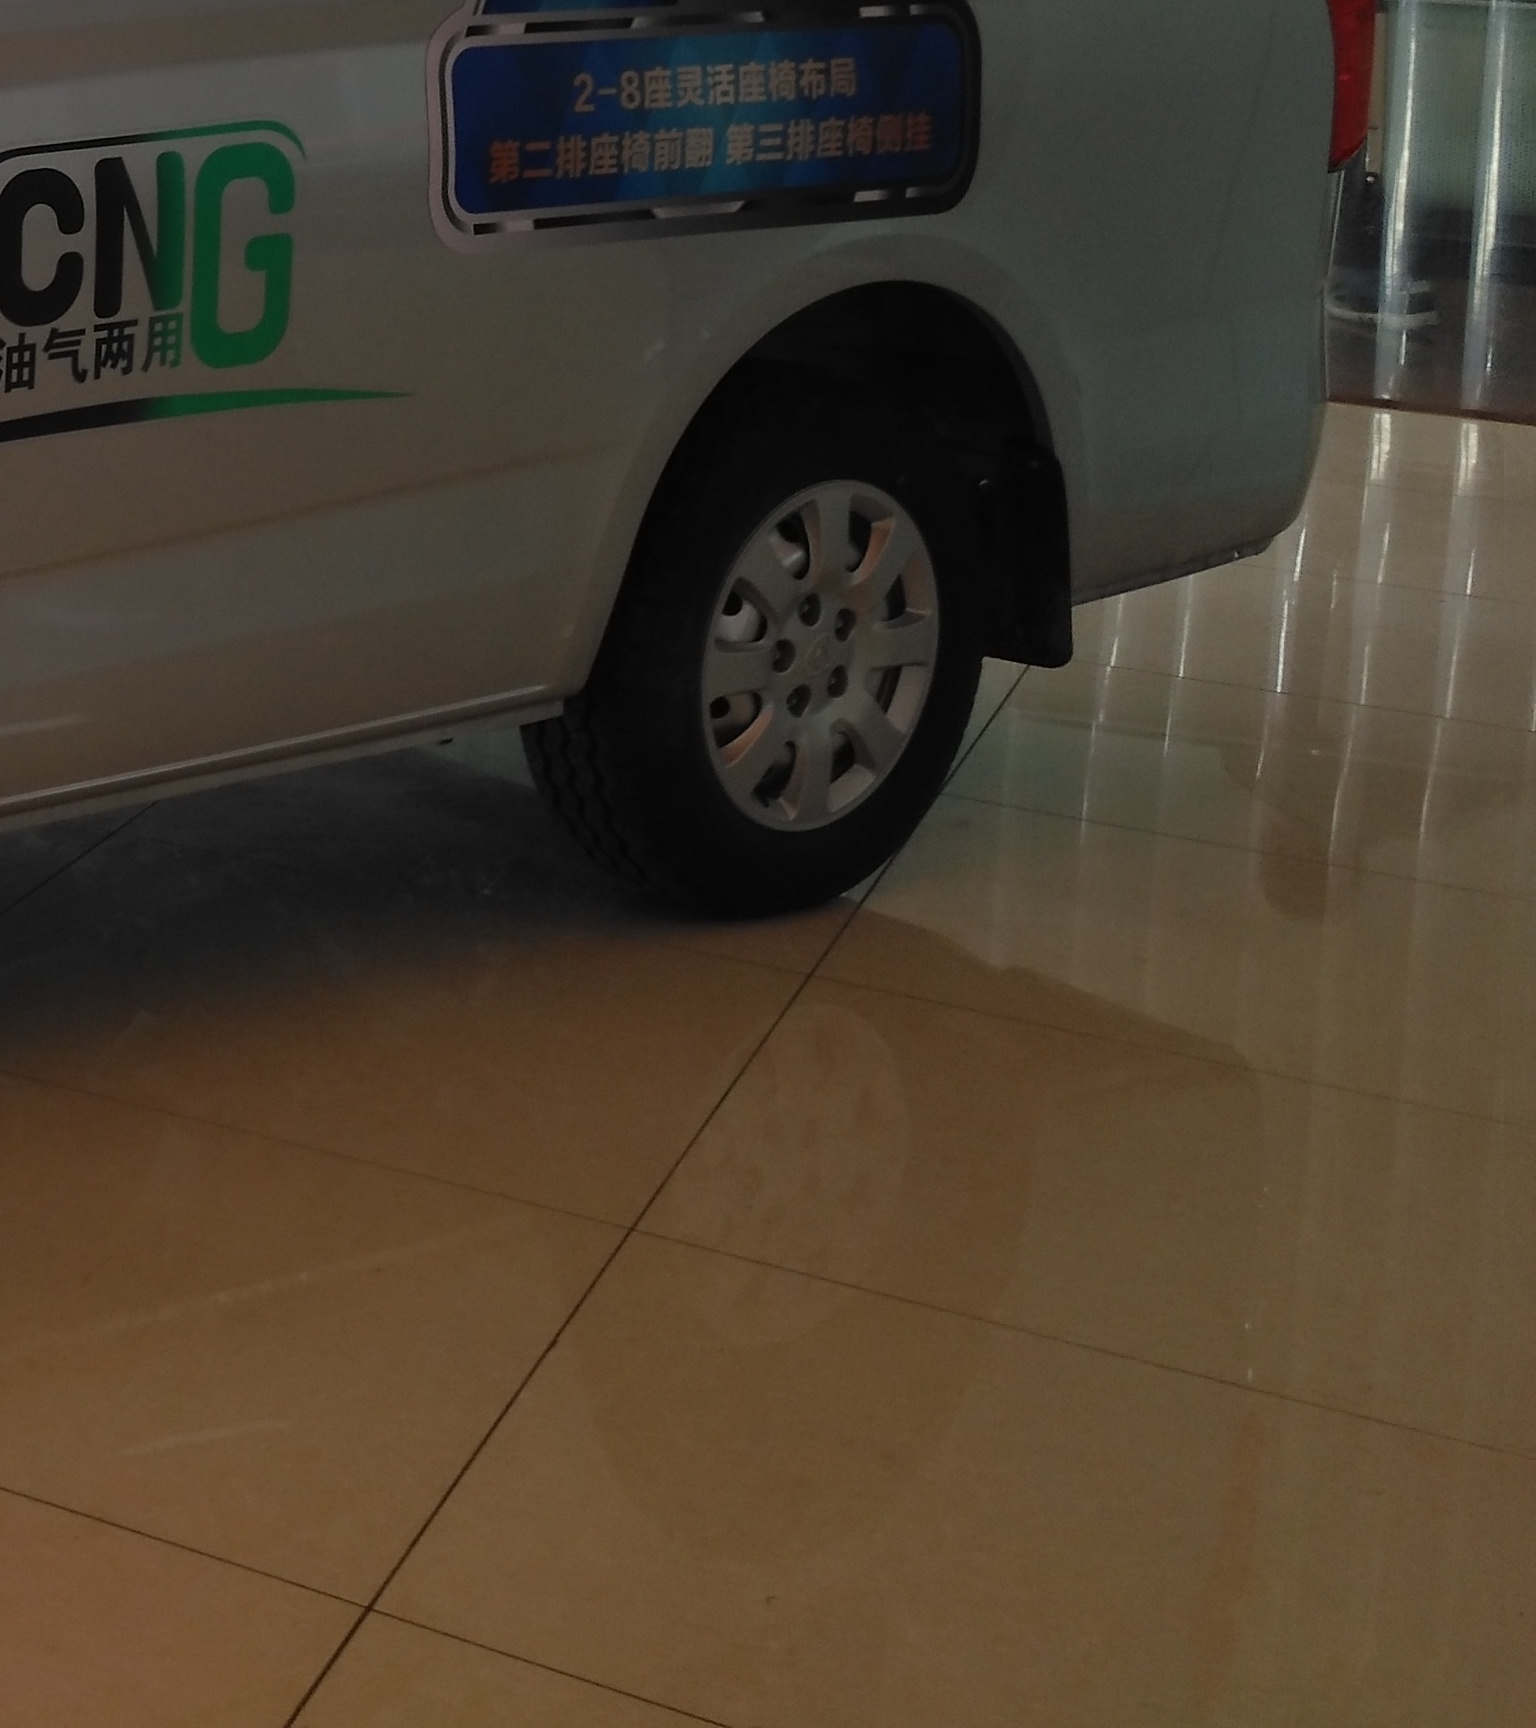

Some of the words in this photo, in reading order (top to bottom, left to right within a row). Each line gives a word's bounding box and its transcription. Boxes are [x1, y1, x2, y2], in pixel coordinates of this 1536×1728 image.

[573, 57, 859, 114] 2-8座灵活座椅布局
